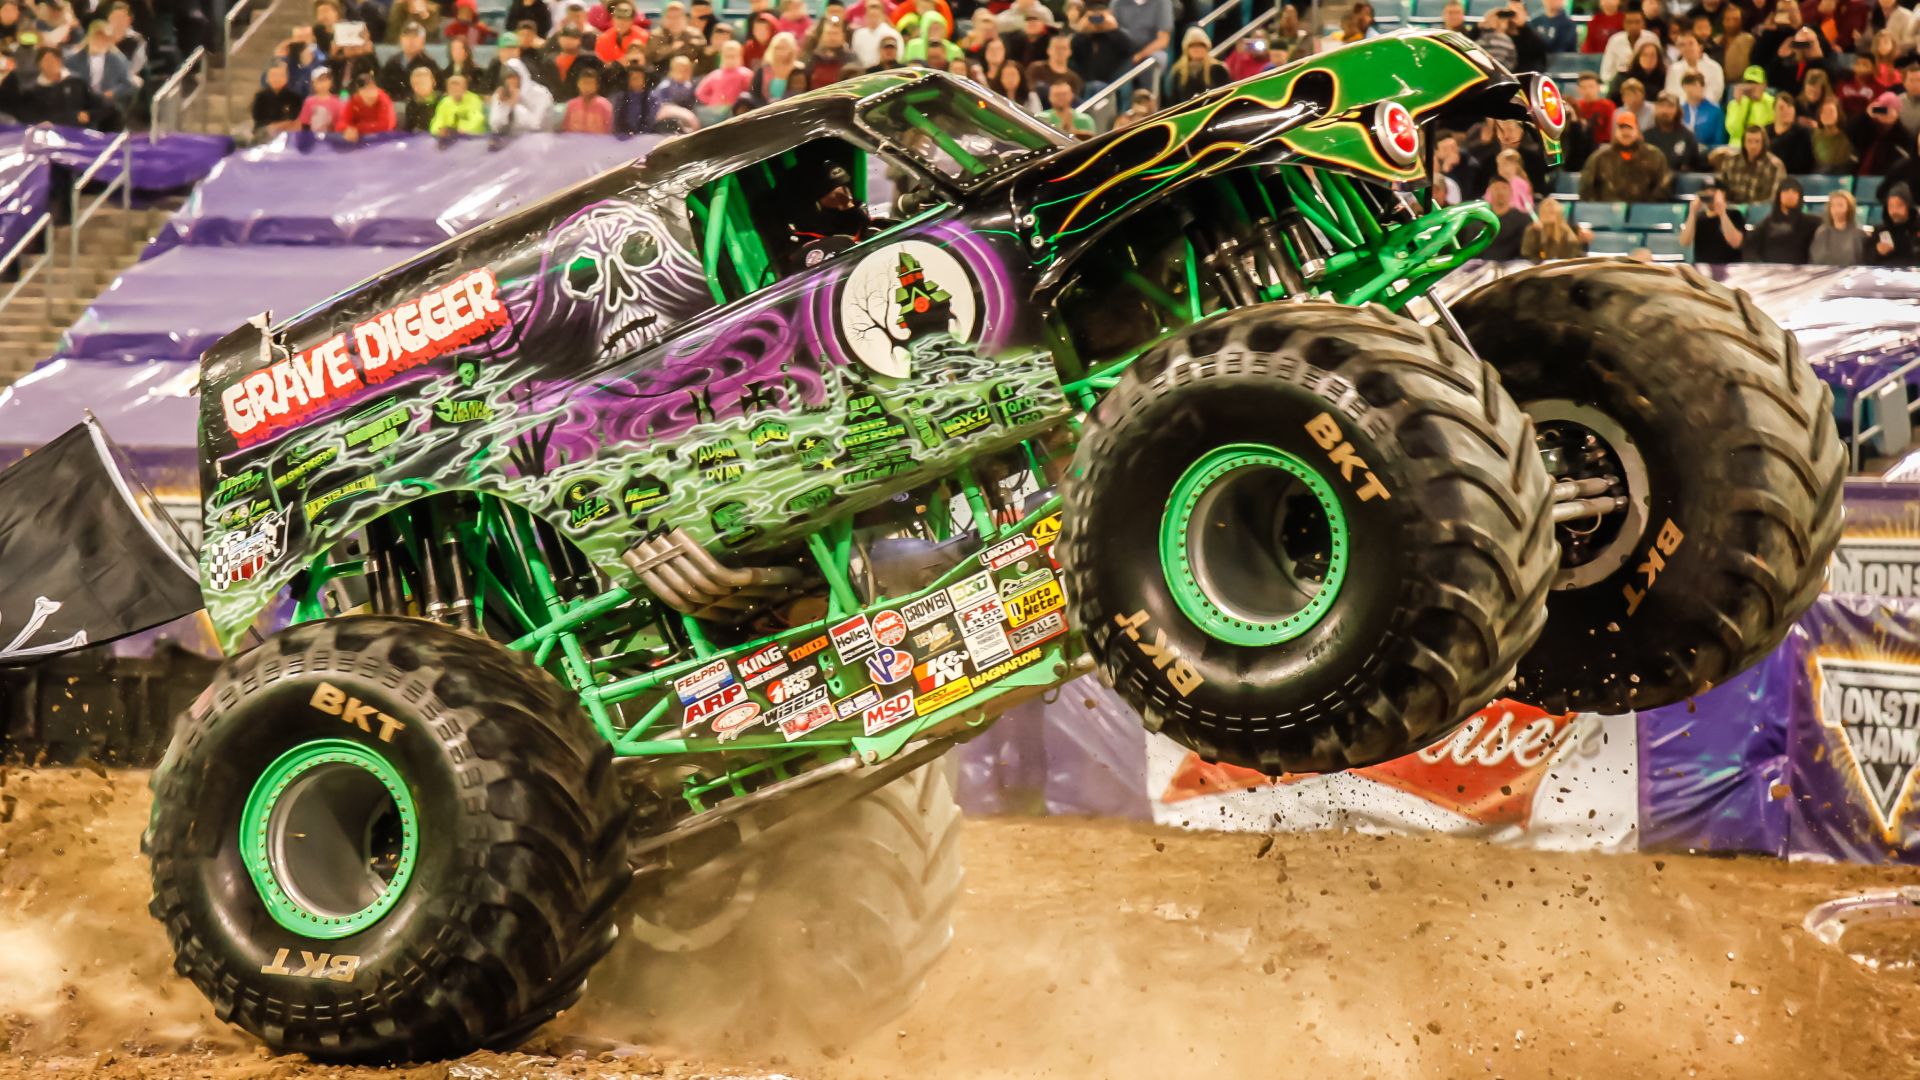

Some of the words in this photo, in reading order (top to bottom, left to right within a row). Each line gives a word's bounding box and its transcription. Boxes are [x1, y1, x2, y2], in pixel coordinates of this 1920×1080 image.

[222, 333, 356, 434] GRAVE
[354, 271, 499, 371] DIGGER
[942, 405, 989, 434] MAX-D
[1304, 412, 1392, 502] BKT
[981, 536, 1025, 564] LINCOLN
[1622, 517, 1684, 617] BKT
[954, 574, 988, 600] BKT
[1023, 587, 1051, 608] Auto
[904, 592, 949, 622] CROWER
[964, 599, 999, 622] FK
[972, 608, 1001, 625] ROD
[1023, 593, 1060, 620] Meter
[836, 627, 871, 649] Holley
[966, 614, 1003, 634] ENDS
[1014, 614, 1060, 645] DERALE
[737, 646, 784, 678] KING
[868, 648, 896, 683] VP
[970, 647, 1042, 688] MAGNAFLOW
[1114, 609, 1205, 698] BKT
[677, 661, 725, 691] FEL-PRO
[782, 665, 818, 685] SPEED
[927, 650, 970, 689] K&N
[685, 684, 742, 724] ARP
[784, 679, 811, 699] PRO
[309, 681, 406, 743] BKT
[867, 694, 911, 727] MSD
[261, 947, 361, 984] BKT
